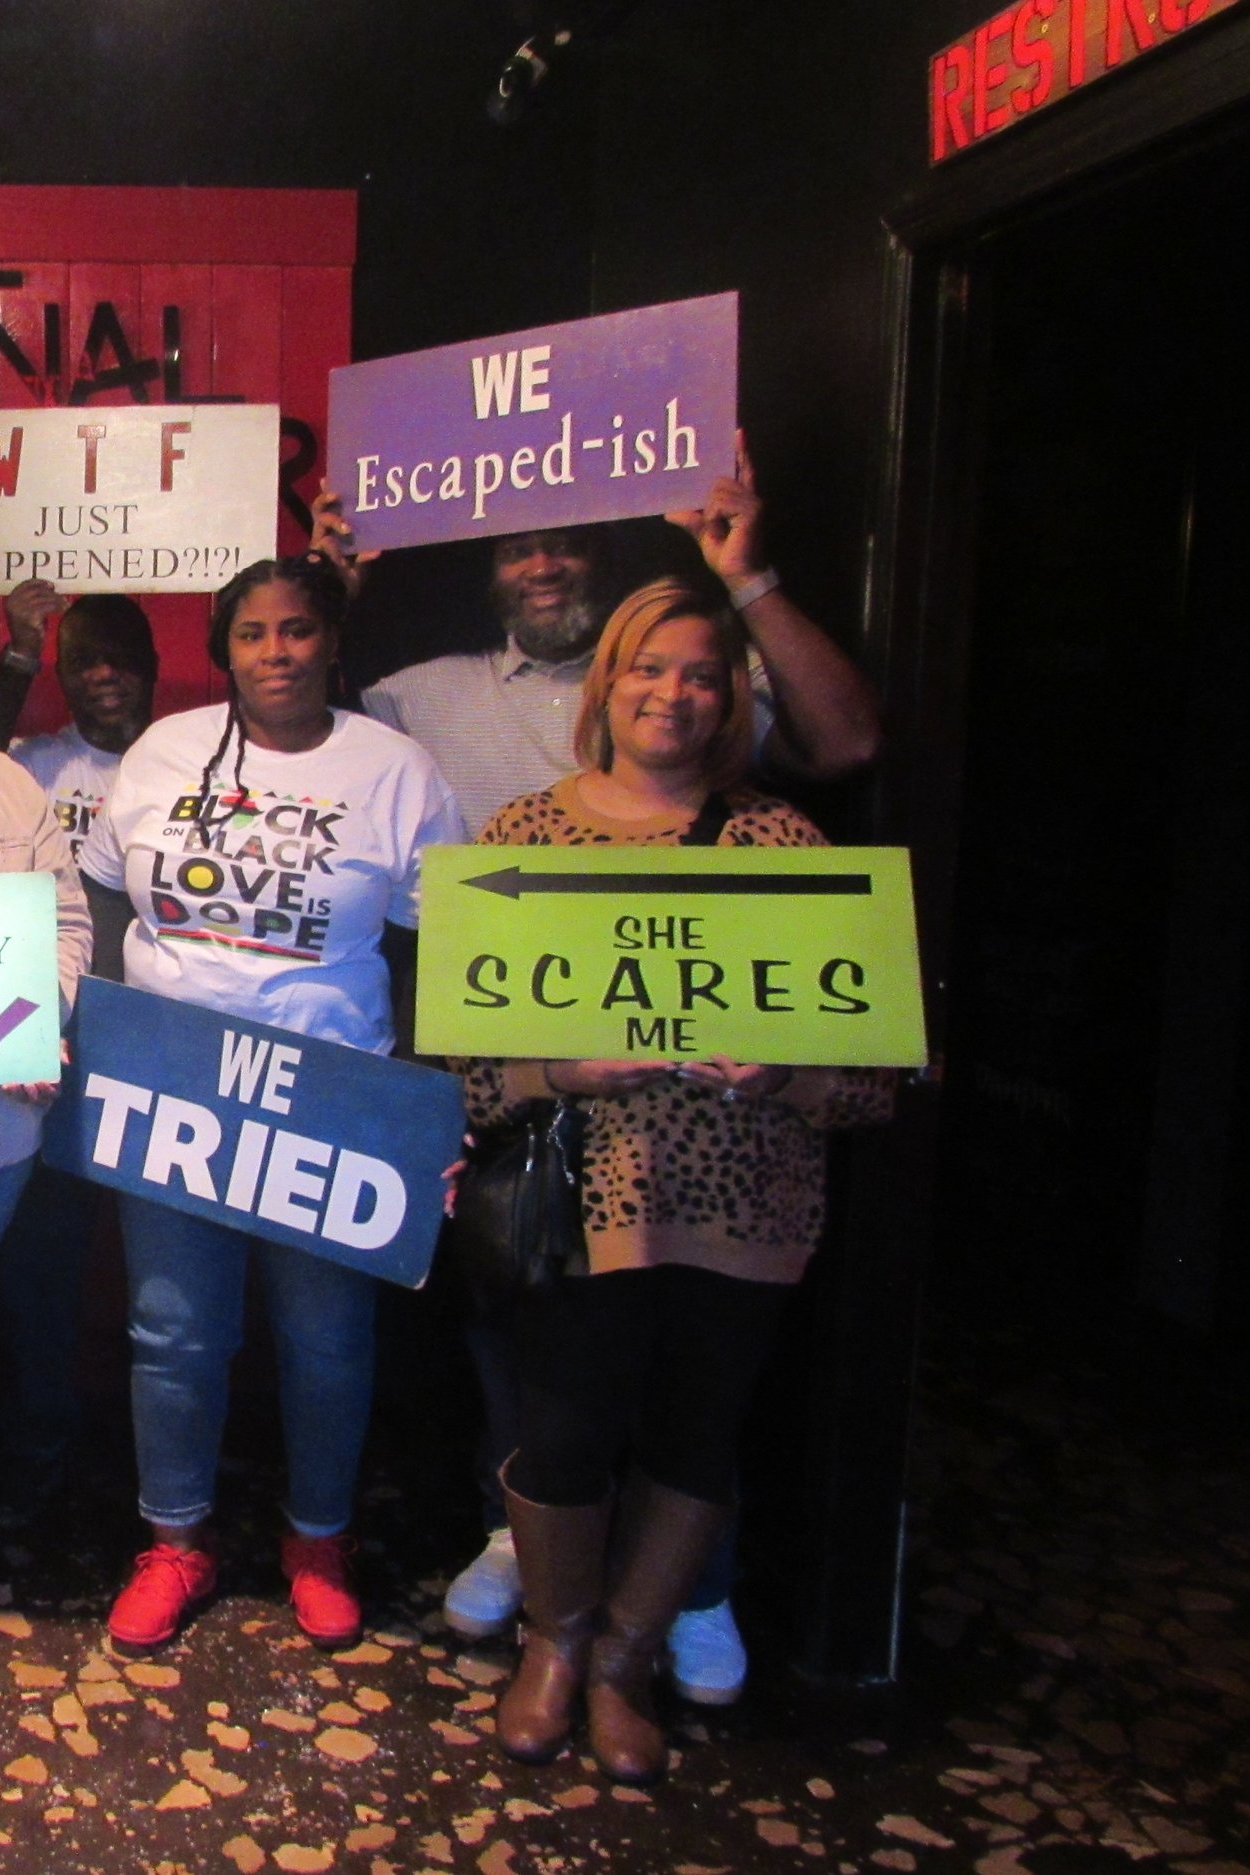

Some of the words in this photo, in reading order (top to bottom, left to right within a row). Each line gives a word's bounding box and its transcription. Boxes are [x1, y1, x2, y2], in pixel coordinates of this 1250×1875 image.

[472, 345, 550, 420] WE
[355, 397, 700, 520] Escaped-ish
[33, 504, 139, 537] JUST
[162, 827, 185, 837] ON
[150, 850, 307, 913] LOVE
[307, 897, 332, 916] IS
[150, 889, 330, 952] DOPE
[612, 915, 706, 951] SHE
[462, 953, 871, 1015] SCARES
[625, 1016, 698, 1053] ME
[217, 1029, 303, 1116] WE
[84, 1072, 407, 1250] TRIED
